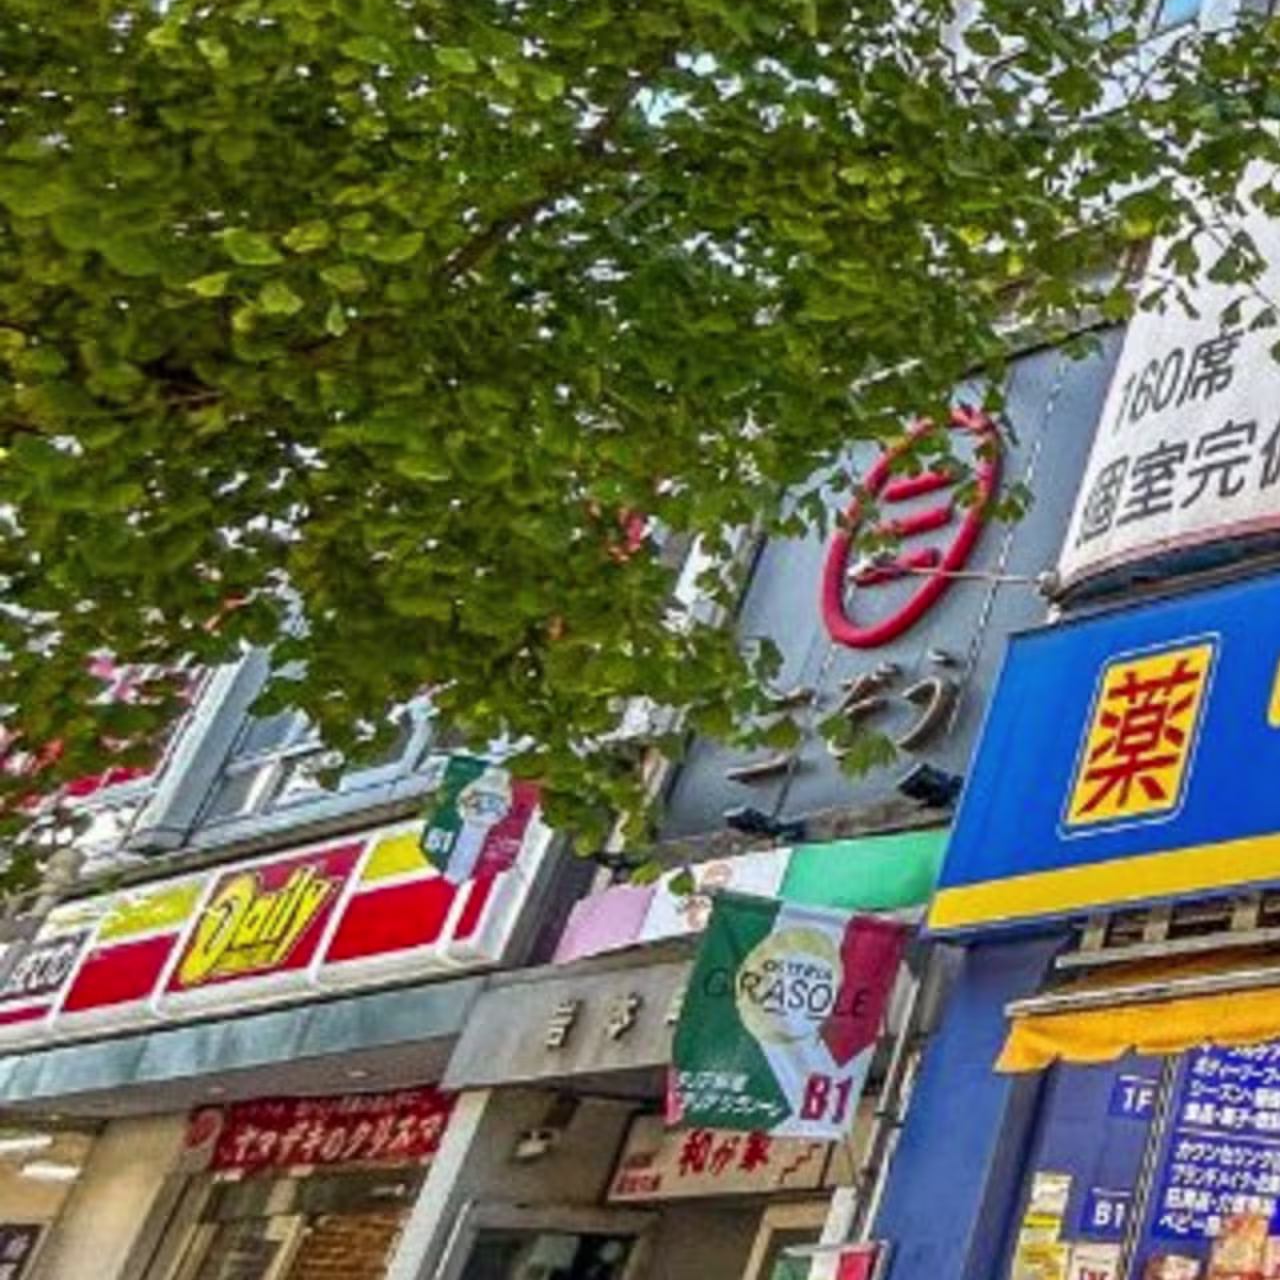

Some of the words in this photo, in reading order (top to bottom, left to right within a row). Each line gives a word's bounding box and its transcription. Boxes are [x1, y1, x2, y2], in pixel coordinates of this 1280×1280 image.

[1078, 664, 1200, 819] 薬
[180, 867, 332, 985] Daily
[801, 1072, 855, 1123] B1
